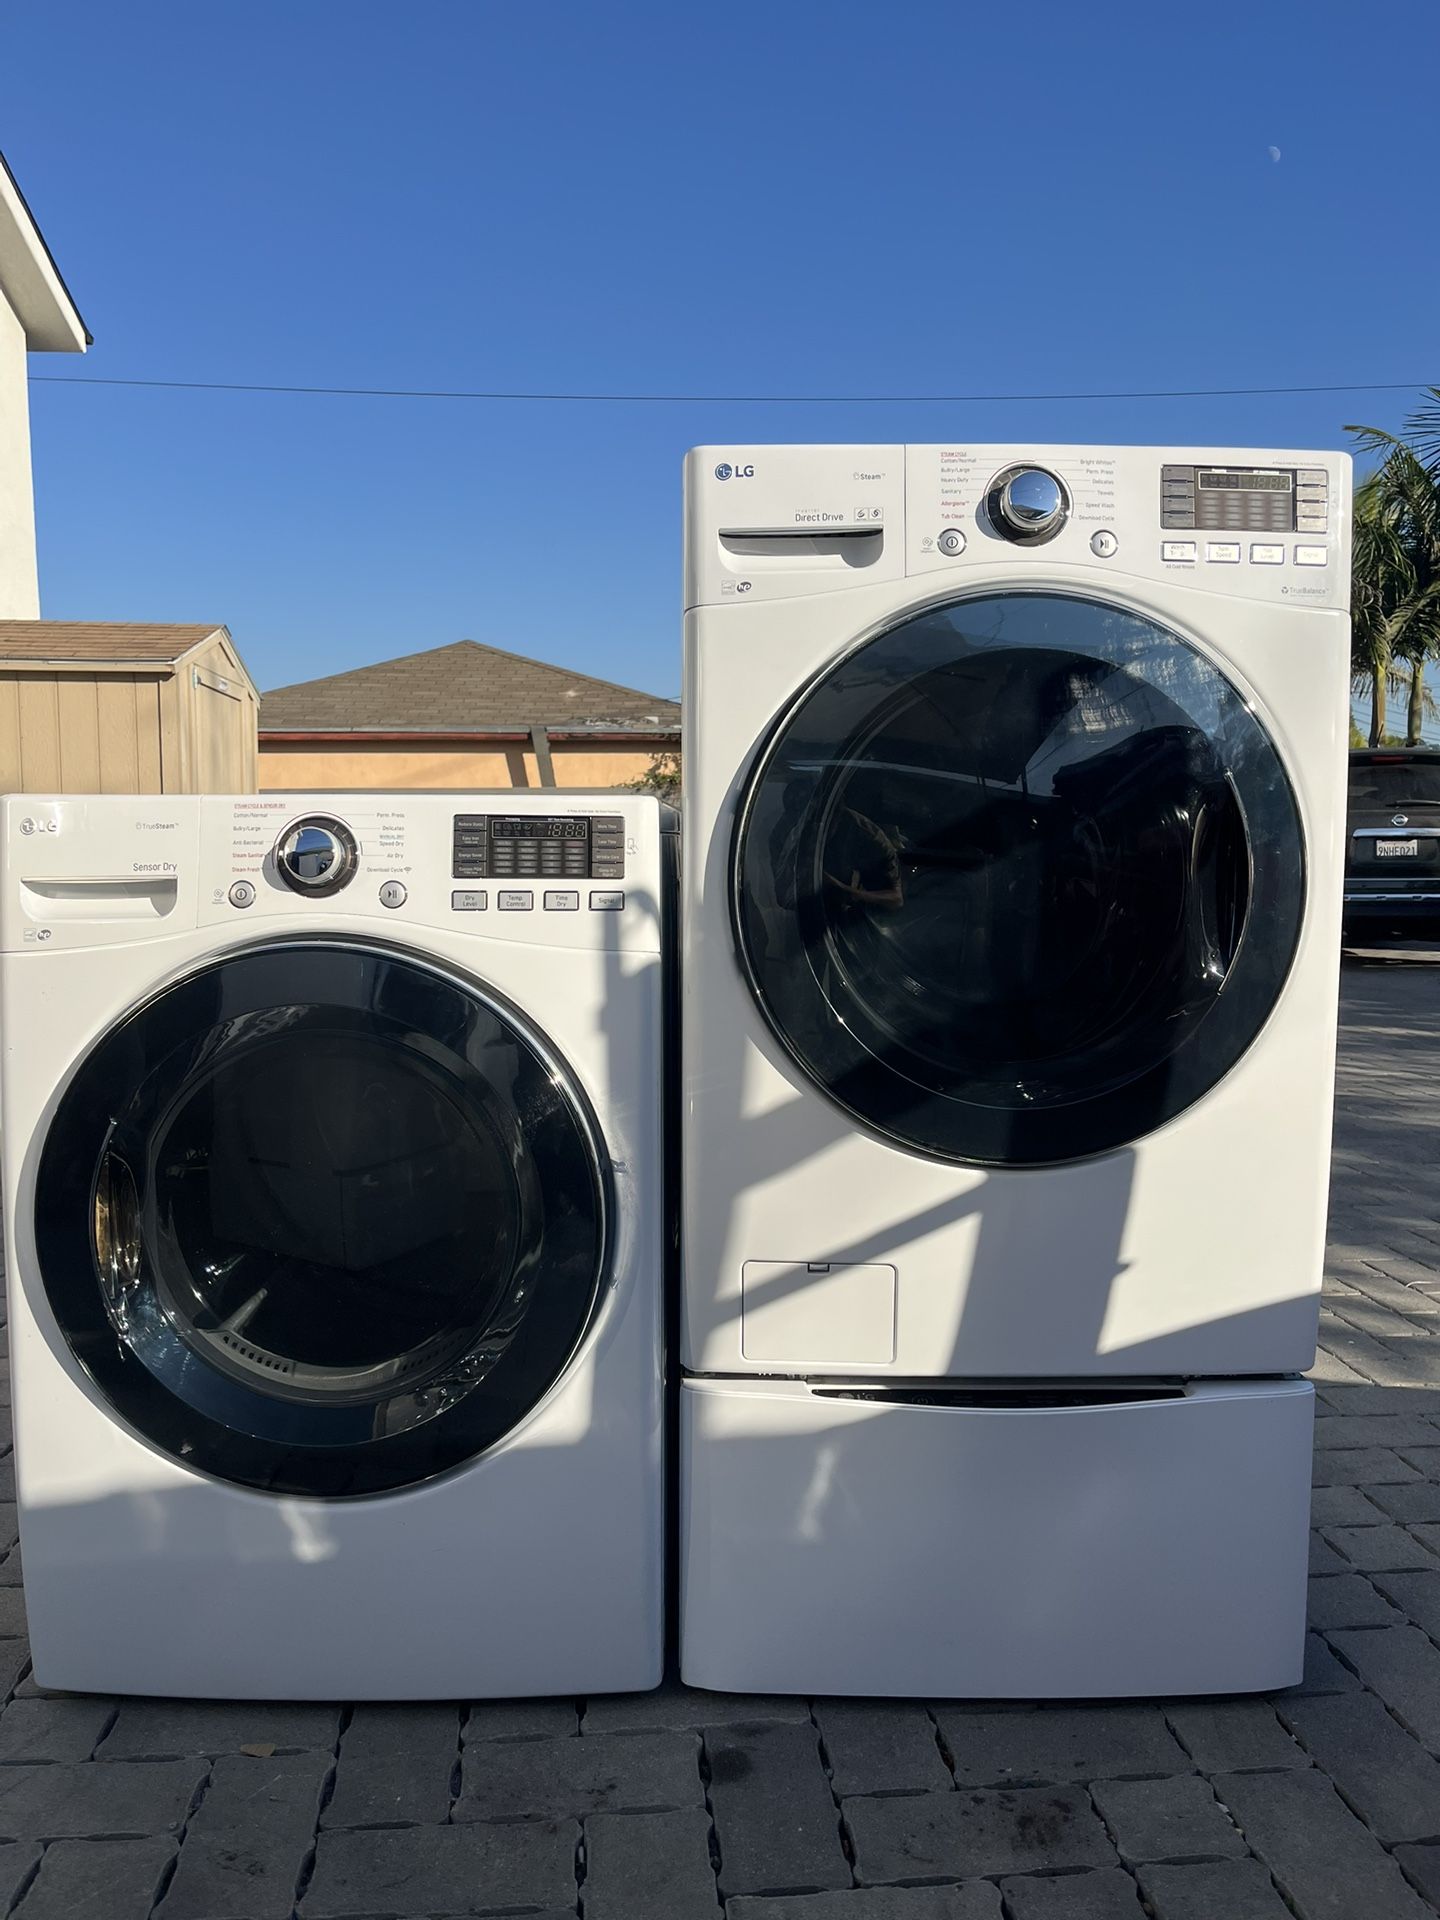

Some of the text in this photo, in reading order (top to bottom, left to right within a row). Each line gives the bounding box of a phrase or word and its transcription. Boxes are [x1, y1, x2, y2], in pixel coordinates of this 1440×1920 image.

[735, 465, 754, 478] LG
[795, 513, 844, 522] Direct Drive
[132, 862, 178, 872] Sensor Dry
